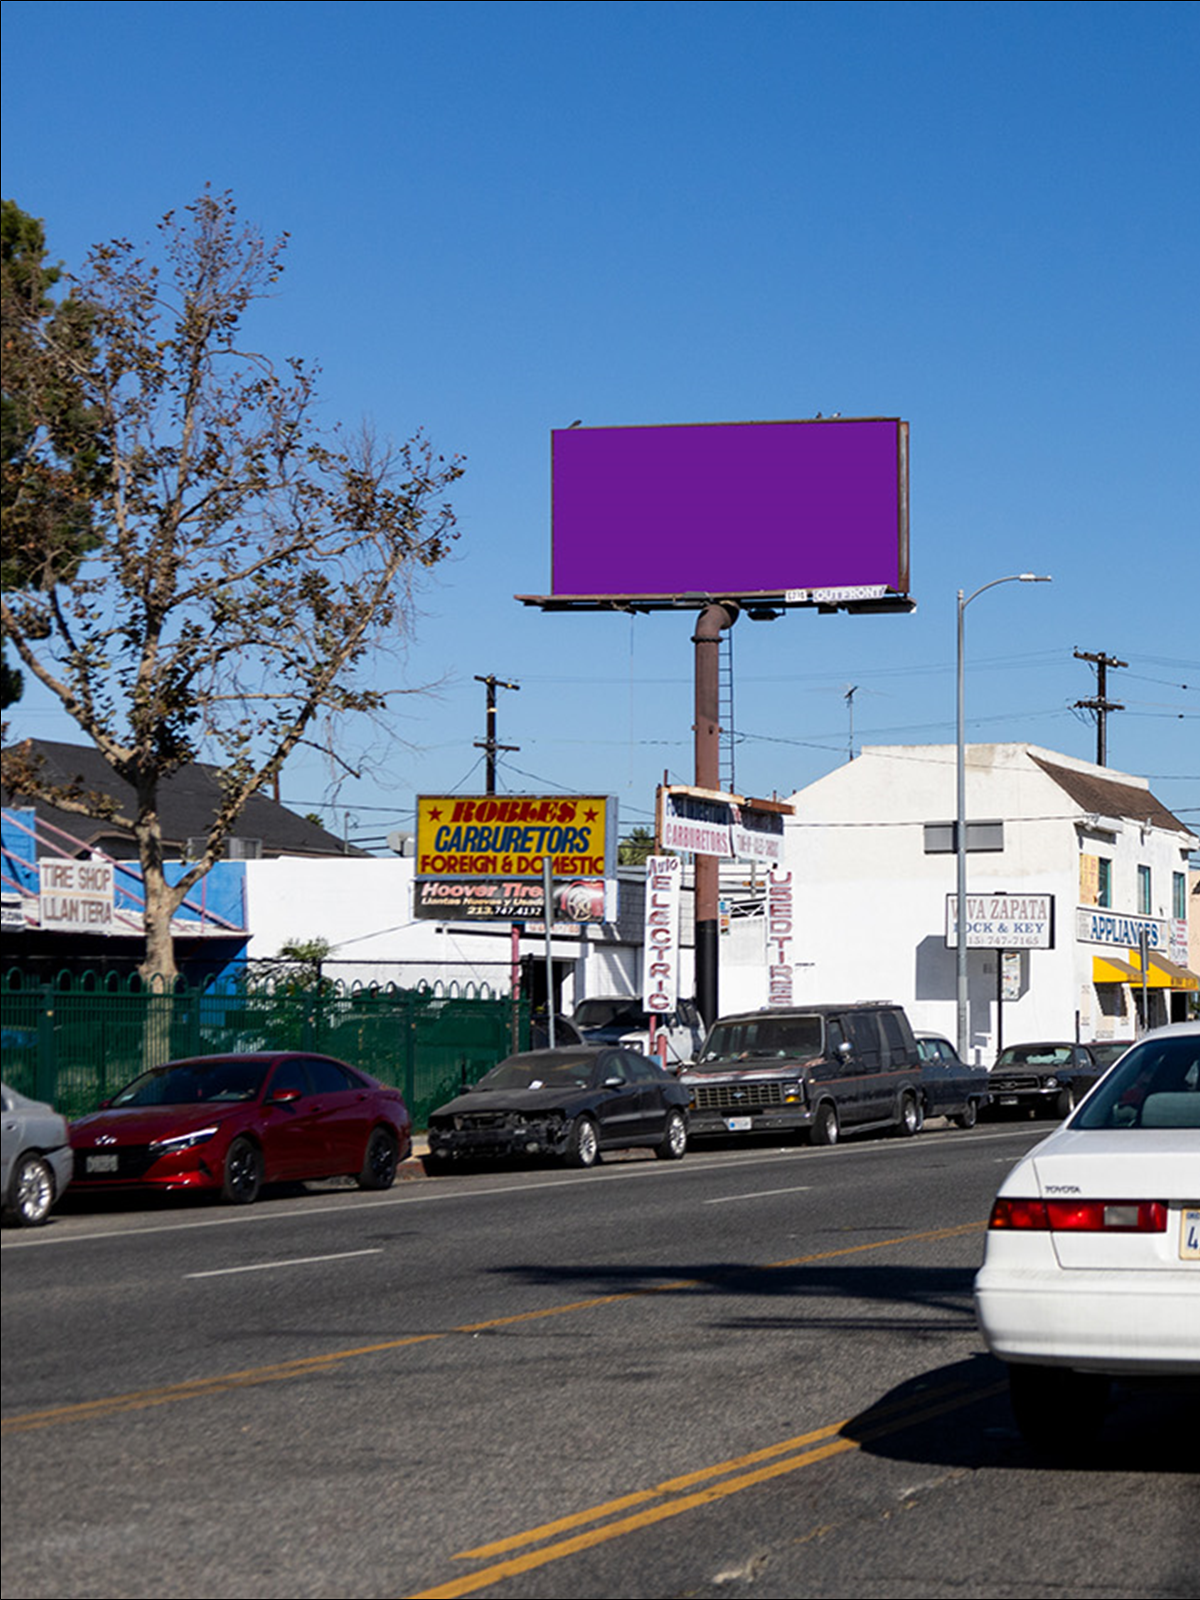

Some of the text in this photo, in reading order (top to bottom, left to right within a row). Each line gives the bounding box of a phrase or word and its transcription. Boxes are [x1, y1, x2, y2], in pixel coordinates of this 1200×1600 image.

[451, 801, 577, 823] ROBLES
[434, 826, 592, 853] CARBURETORS
[665, 823, 728, 853] CARBURETORS
[420, 855, 497, 873] FOREIGN
[501, 855, 513, 873] &
[42, 864, 111, 891] TIRE SHOP
[421, 882, 544, 897] Hoover Tire
[513, 898, 544, 906] Usad
[950, 899, 1047, 919] VVA ZAPATA
[997, 922, 1008, 933] &
[1013, 922, 1044, 933] KEY
[648, 874, 672, 1010] ELECTRIC
[1045, 1186, 1081, 1194] TOYOTA
